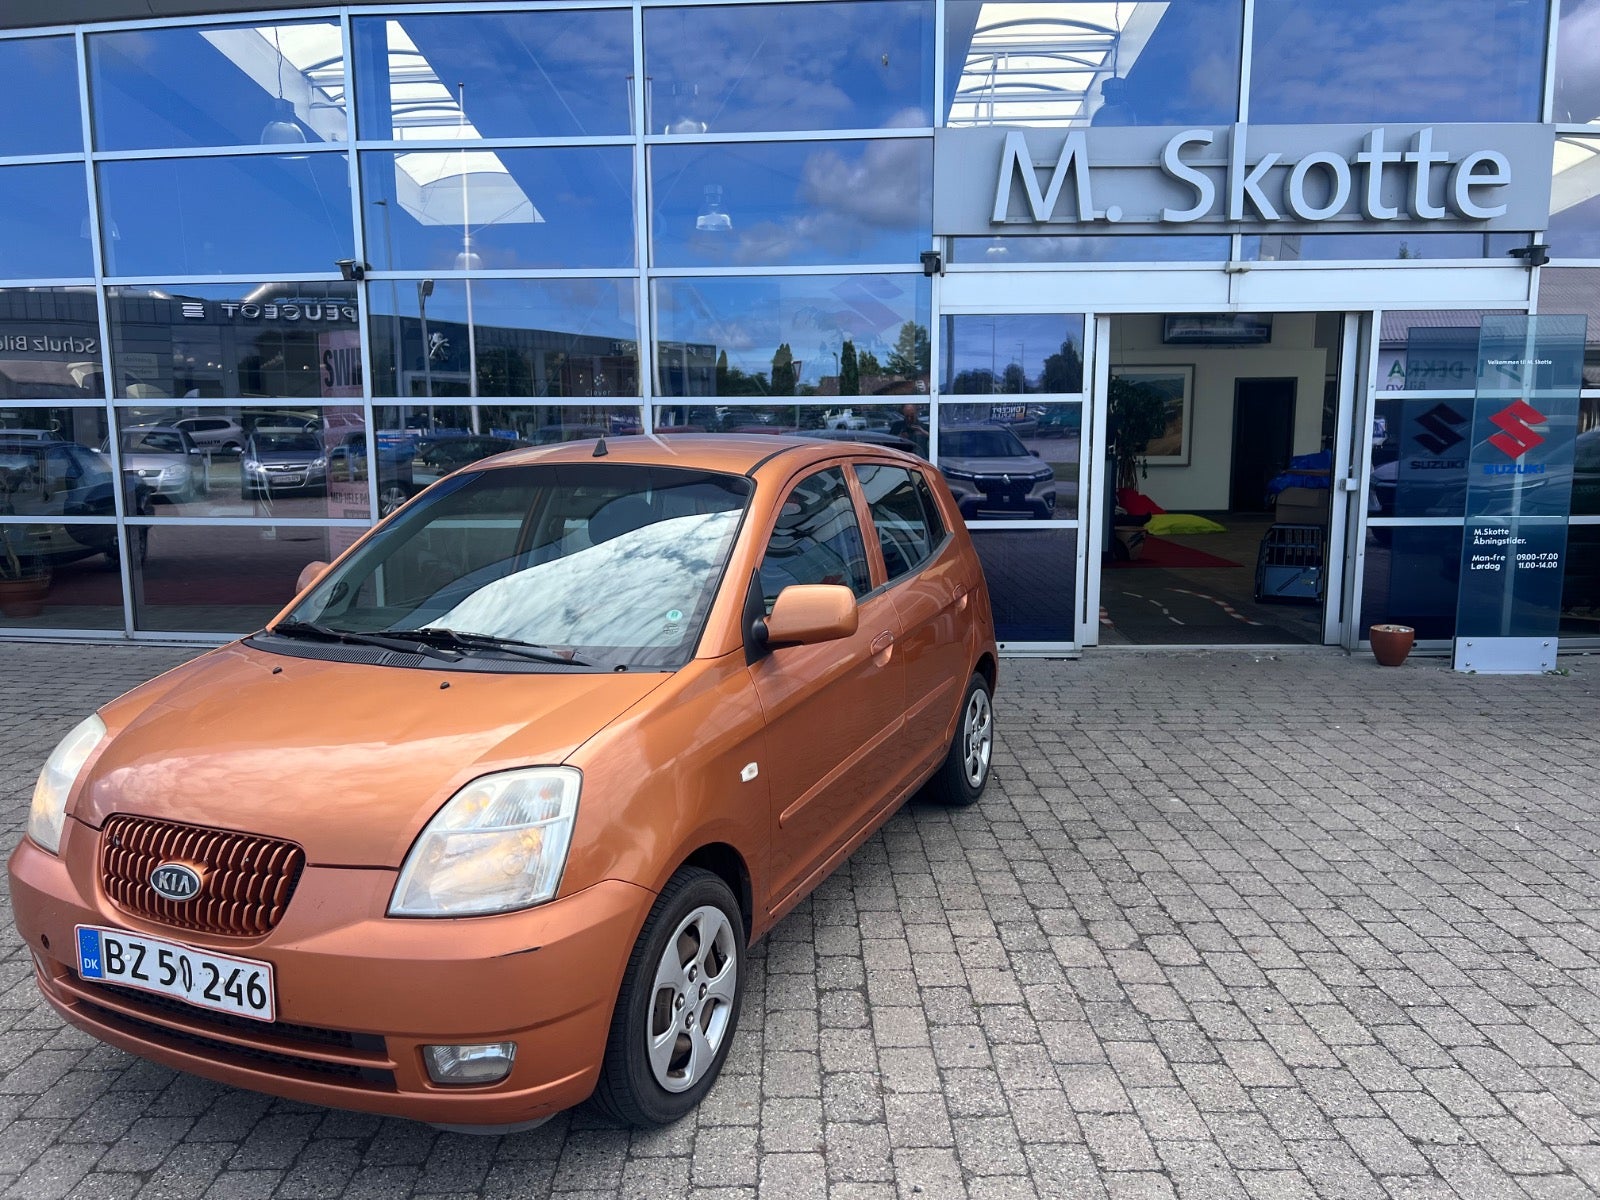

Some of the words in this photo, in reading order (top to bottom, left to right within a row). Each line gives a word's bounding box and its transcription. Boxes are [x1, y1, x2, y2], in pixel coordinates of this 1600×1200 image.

[990, 130, 1123, 223] M.
[1160, 122, 1512, 223] Skotte
[1410, 460, 1465, 470] SUZUKI
[1483, 463, 1545, 475] SUZUKI
[1473, 528, 1510, 536] M.Skotte
[1473, 536, 1527, 546] Åbningstider.
[1472, 554, 1506, 562] Man-fre
[1516, 553, 1559, 561] 09.00-17.00
[1470, 562, 1501, 571] Lørdag
[1518, 561, 1558, 569] 11.00-14.00
[158, 871, 191, 894] KIA
[84, 957, 99, 970] DK
[104, 938, 149, 981] BZ
[202, 961, 267, 1010] 246
